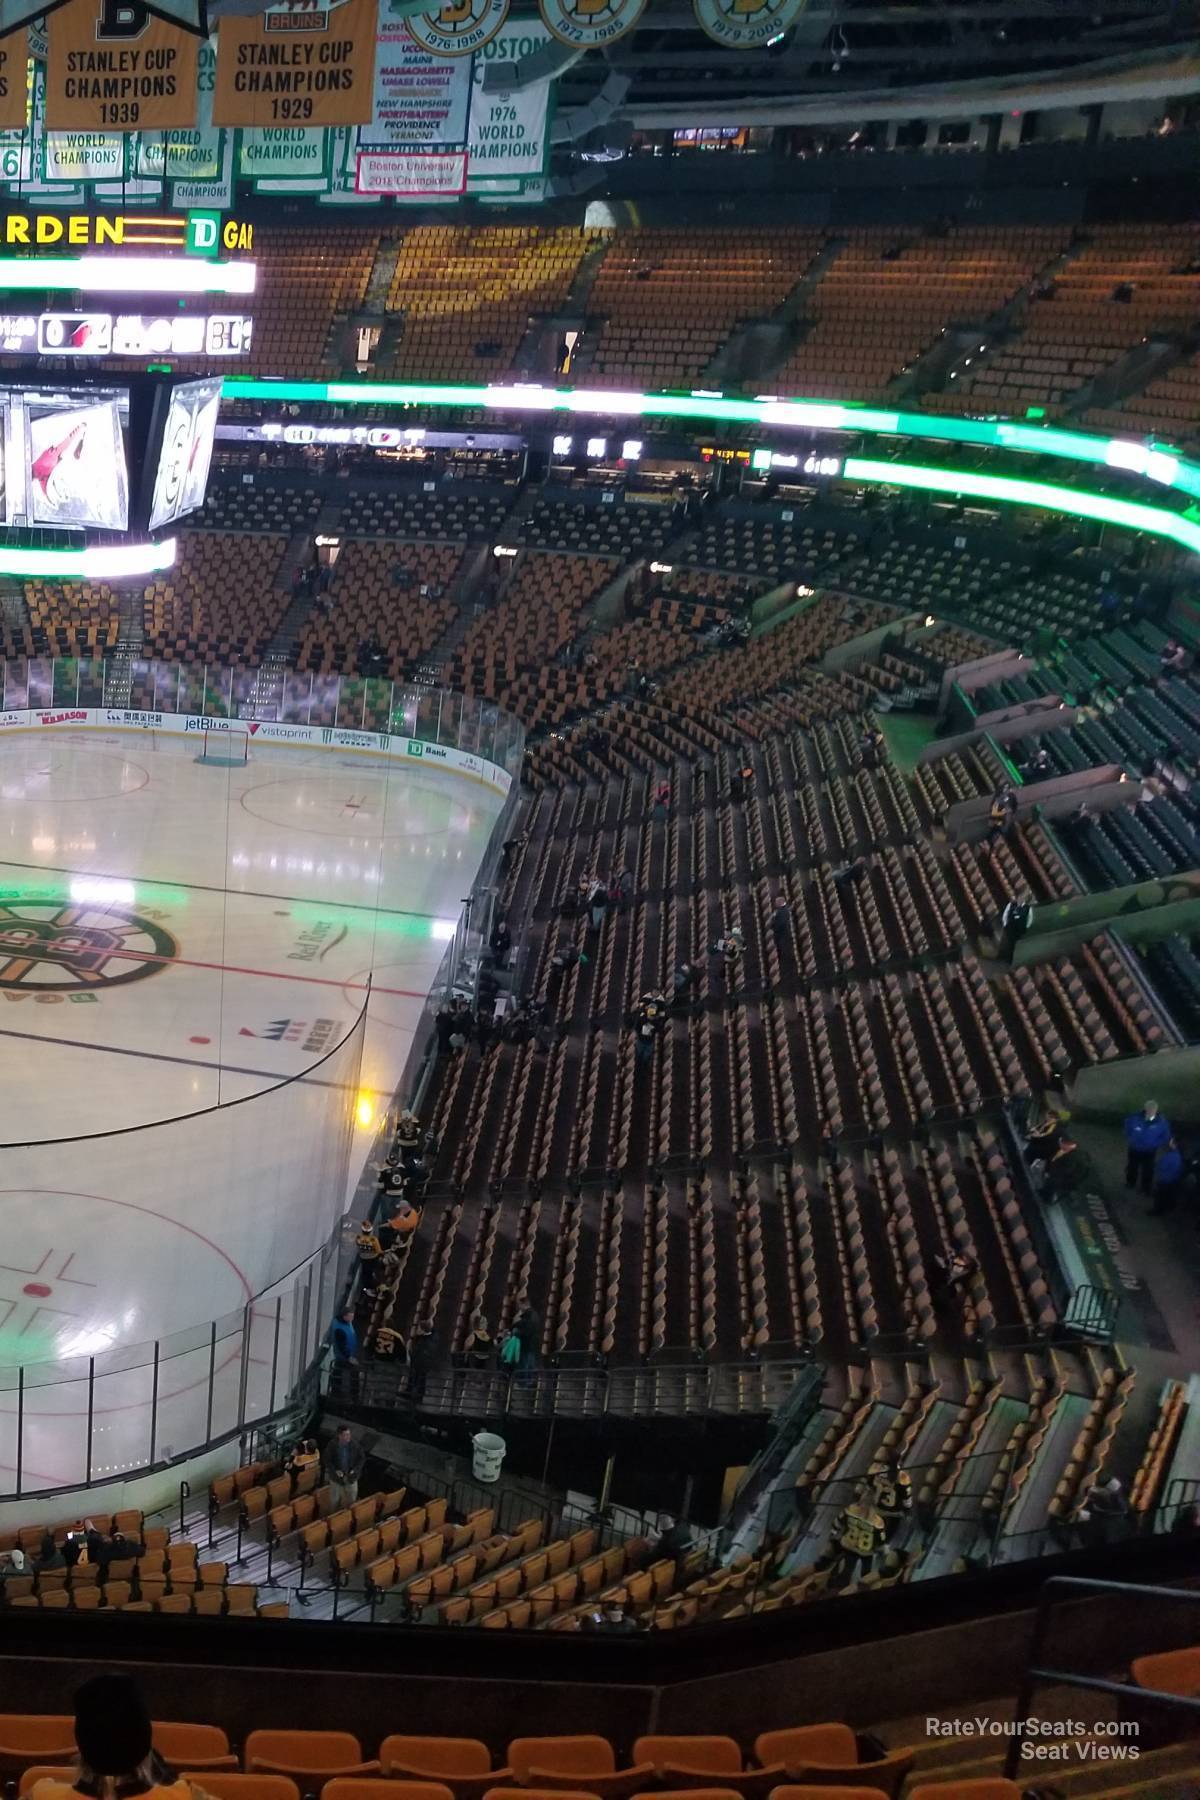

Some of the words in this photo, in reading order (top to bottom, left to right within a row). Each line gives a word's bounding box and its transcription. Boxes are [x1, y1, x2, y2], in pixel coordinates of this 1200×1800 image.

[270, 14, 324, 29] BRUINS
[67, 51, 140, 72] STANLEY
[144, 49, 176, 70] CUP
[237, 43, 314, 65] STANLEY
[319, 41, 354, 63] CUP
[65, 75, 176, 98] CHAMPIONS
[234, 69, 353, 92] CHAMPIONS
[100, 102, 139, 123] 1939
[271, 98, 313, 119] 1929
[490, 106, 517, 121] 1976
[384, 121, 441, 129] PROVIDENCE
[67, 134, 105, 147] WORLD
[160, 130, 201, 145] WORLD
[262, 128, 305, 142] WORLD
[390, 132, 434, 140] VERMONT
[478, 127, 525, 140] WORLD
[54, 151, 117, 165] CHAMPIONS
[145, 146, 213, 162] CHAMPIONS
[246, 145, 318, 160] CHAMPIONS
[467, 142, 539, 159] HAMPIONS
[2, 150, 19, 176] 6
[369, 160, 404, 171] Boston
[406, 161, 456, 175] University
[190, 217, 217, 248] TD
[184, 715, 229, 732] jetBlue
[261, 726, 313, 740] vistaprint
[425, 746, 448, 759] Bank
